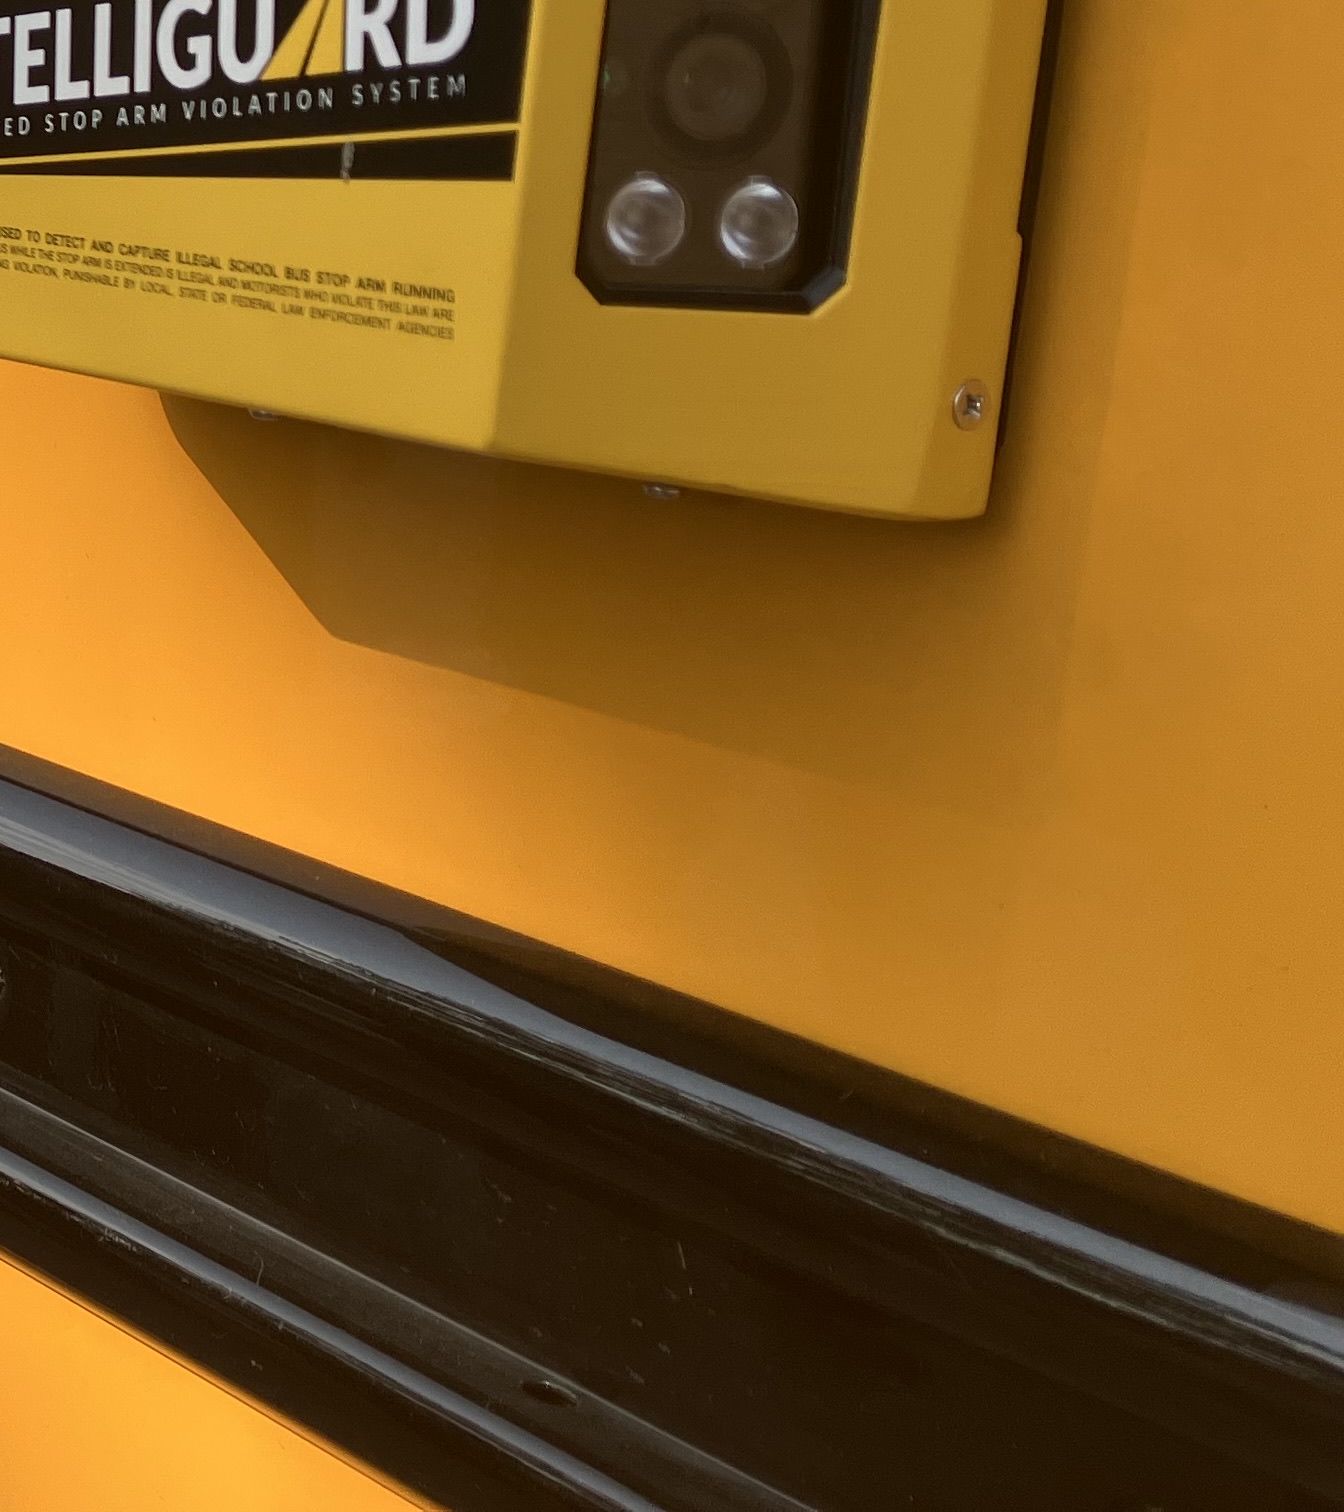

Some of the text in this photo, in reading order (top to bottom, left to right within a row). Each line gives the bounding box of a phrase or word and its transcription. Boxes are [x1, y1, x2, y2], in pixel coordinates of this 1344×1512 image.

[43, 108, 104, 136] STOP
[115, 101, 168, 128] ARM
[180, 86, 335, 121] VIOLATION
[350, 73, 468, 106] SYSTEM
[26, 229, 41, 243] TO
[45, 232, 86, 250] DETECT
[90, 239, 113, 254] AND
[117, 243, 171, 263] CAPTURE
[175, 251, 223, 270] ILLEGAL
[228, 257, 279, 278] SCHOOL
[284, 265, 311, 283] BUS
[316, 270, 351, 288] STOP
[355, 276, 387, 294] ARM
[392, 280, 456, 304] RUNNING
